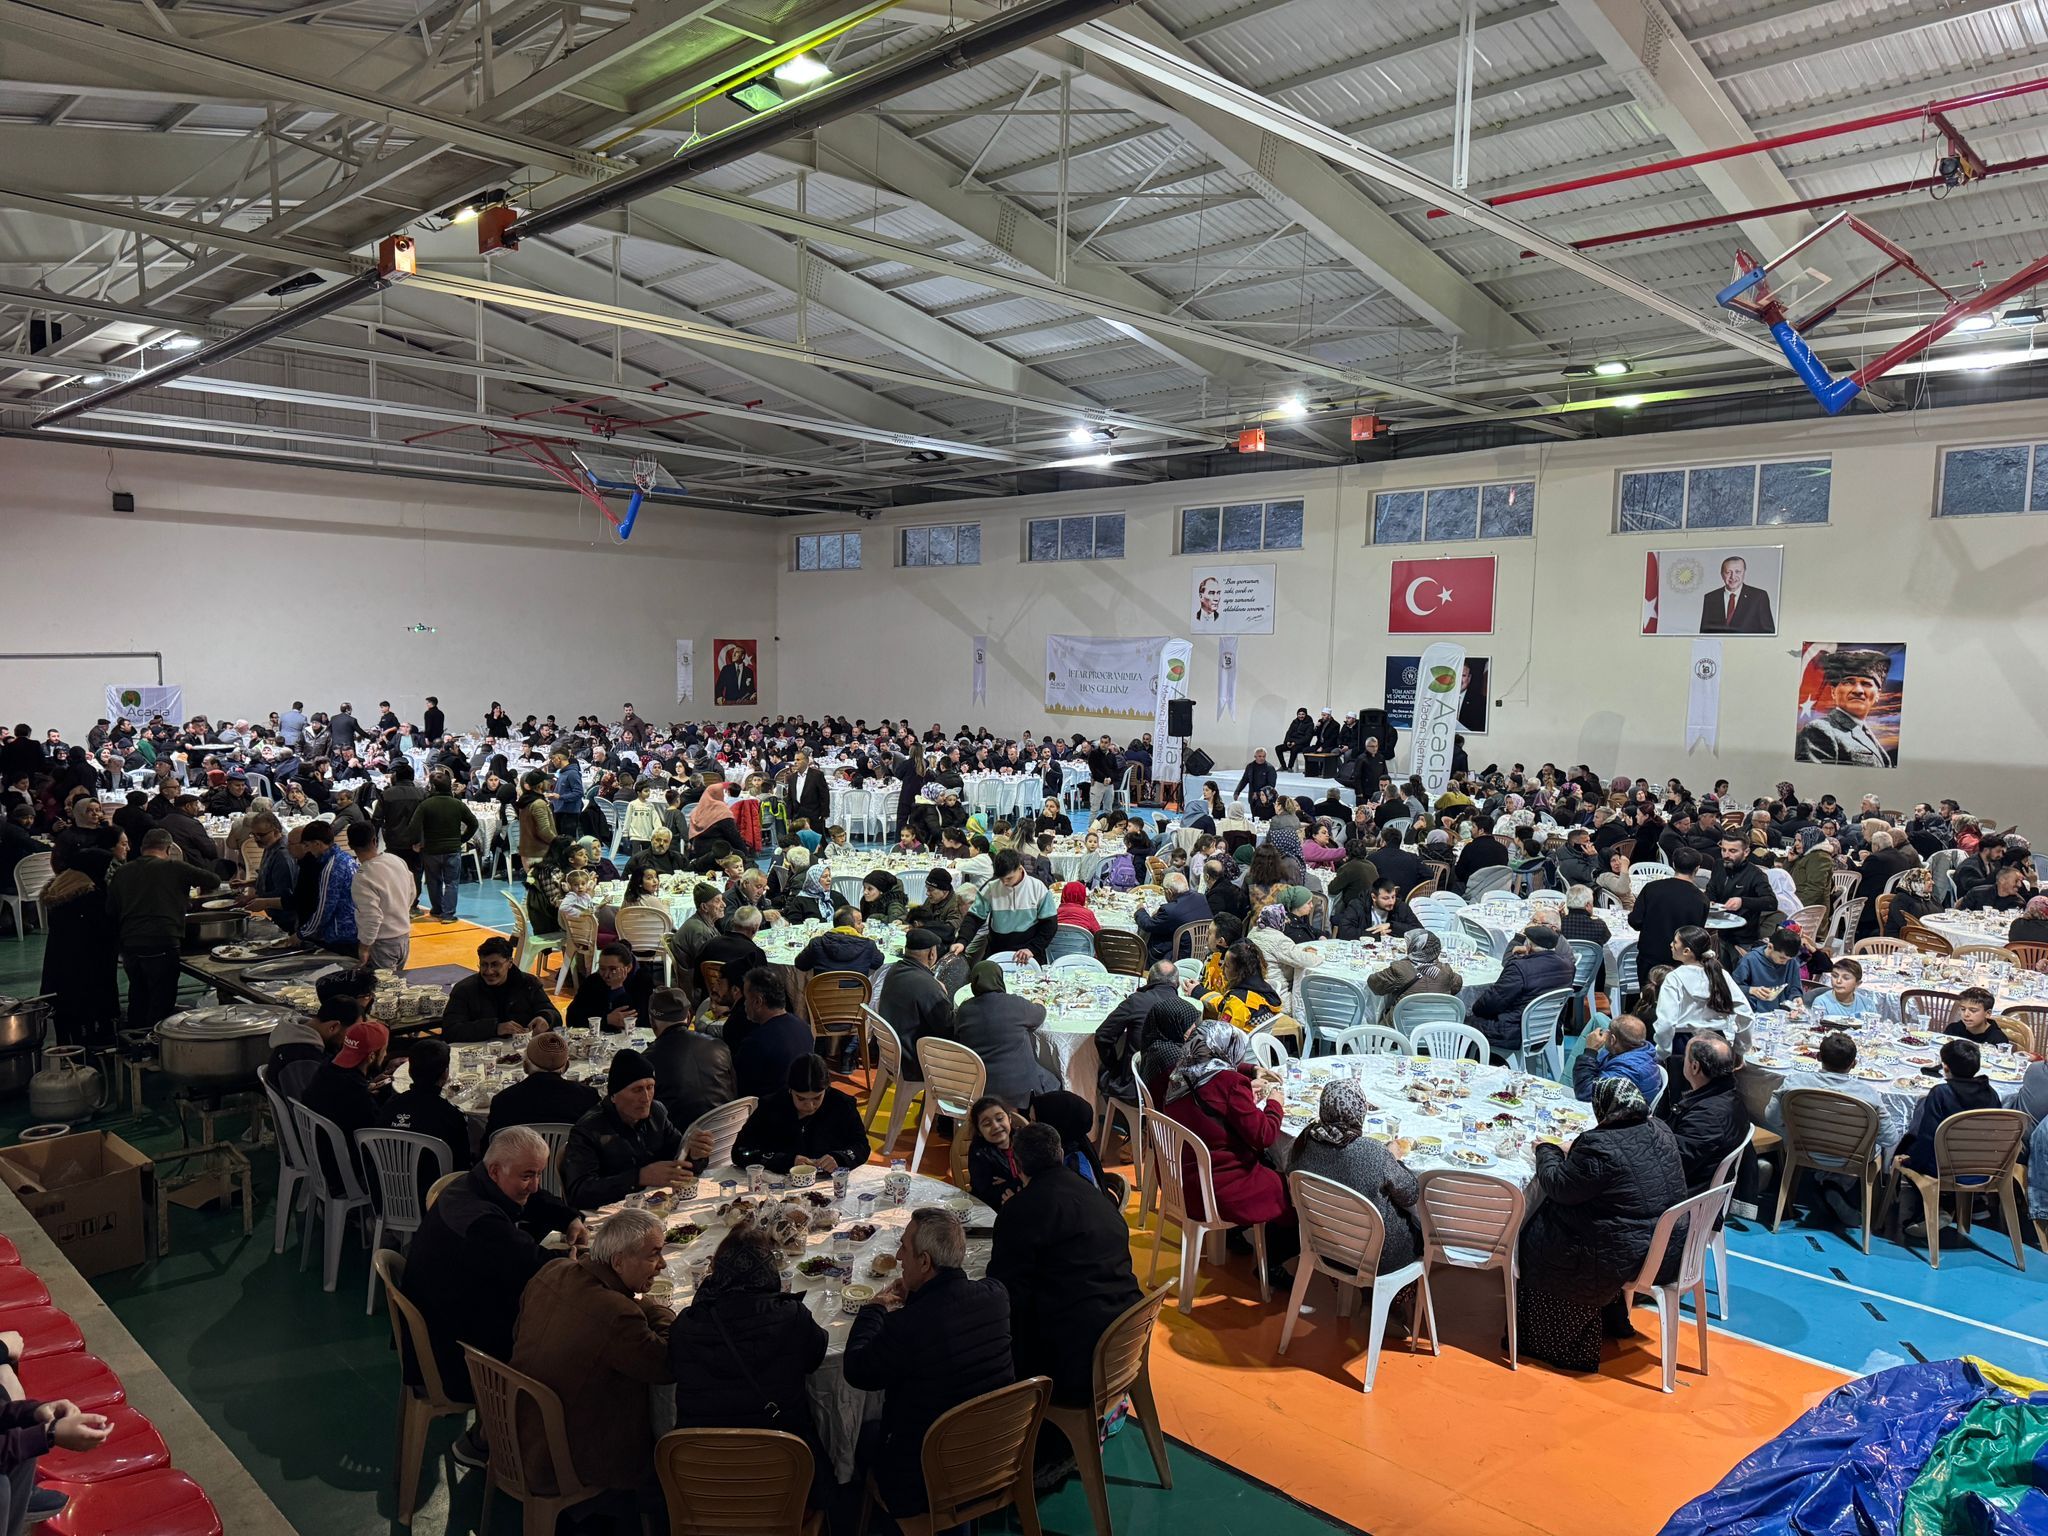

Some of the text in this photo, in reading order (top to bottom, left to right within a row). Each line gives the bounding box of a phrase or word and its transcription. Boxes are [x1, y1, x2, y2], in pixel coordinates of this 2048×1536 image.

[1080, 684, 1129, 694] HOŞ GELDİNİZ
[126, 707, 170, 716] Acacia
[1420, 697, 1432, 734] Maden
[1428, 699, 1456, 790] Acacia
